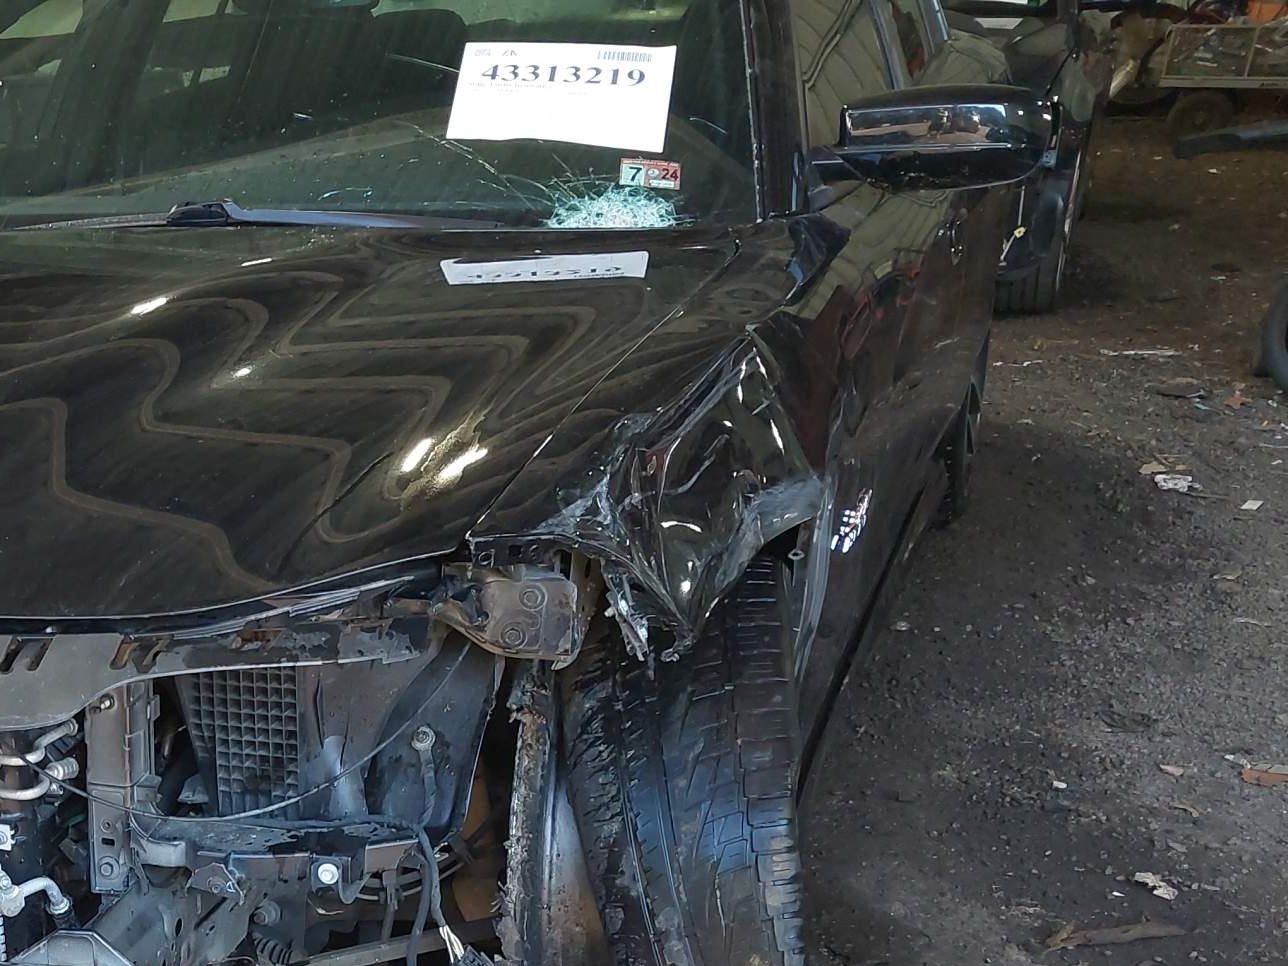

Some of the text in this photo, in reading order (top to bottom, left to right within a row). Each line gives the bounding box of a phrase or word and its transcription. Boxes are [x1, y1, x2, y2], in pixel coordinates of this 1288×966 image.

[481, 64, 646, 86] 43313219
[628, 166, 679, 182] 7 24
